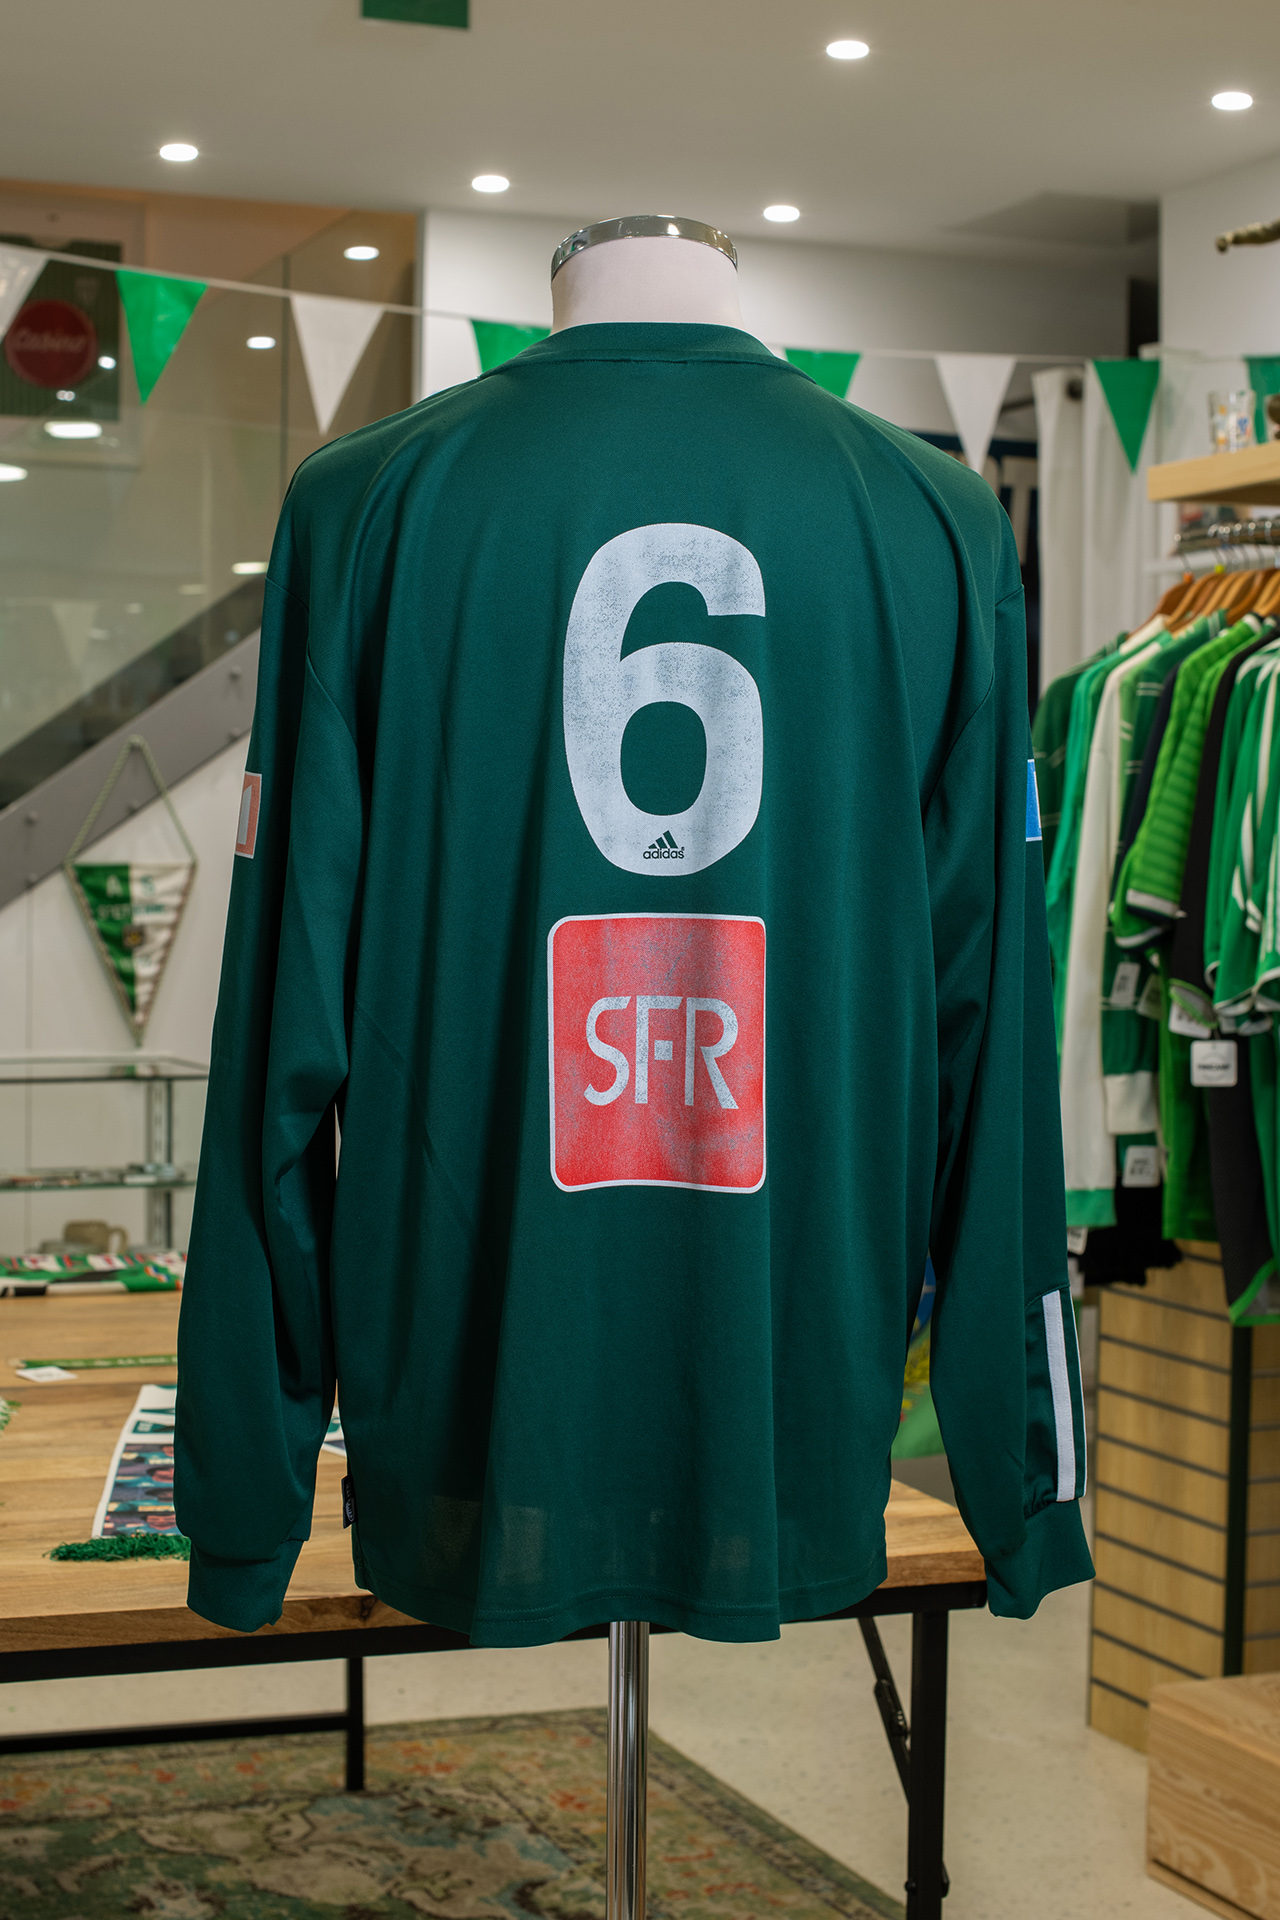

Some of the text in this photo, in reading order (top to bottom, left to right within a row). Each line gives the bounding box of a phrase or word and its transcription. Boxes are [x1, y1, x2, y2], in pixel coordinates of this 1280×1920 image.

[563, 523, 765, 876] 6
[643, 848, 685, 860] adidas
[583, 995, 739, 1109] SFR
